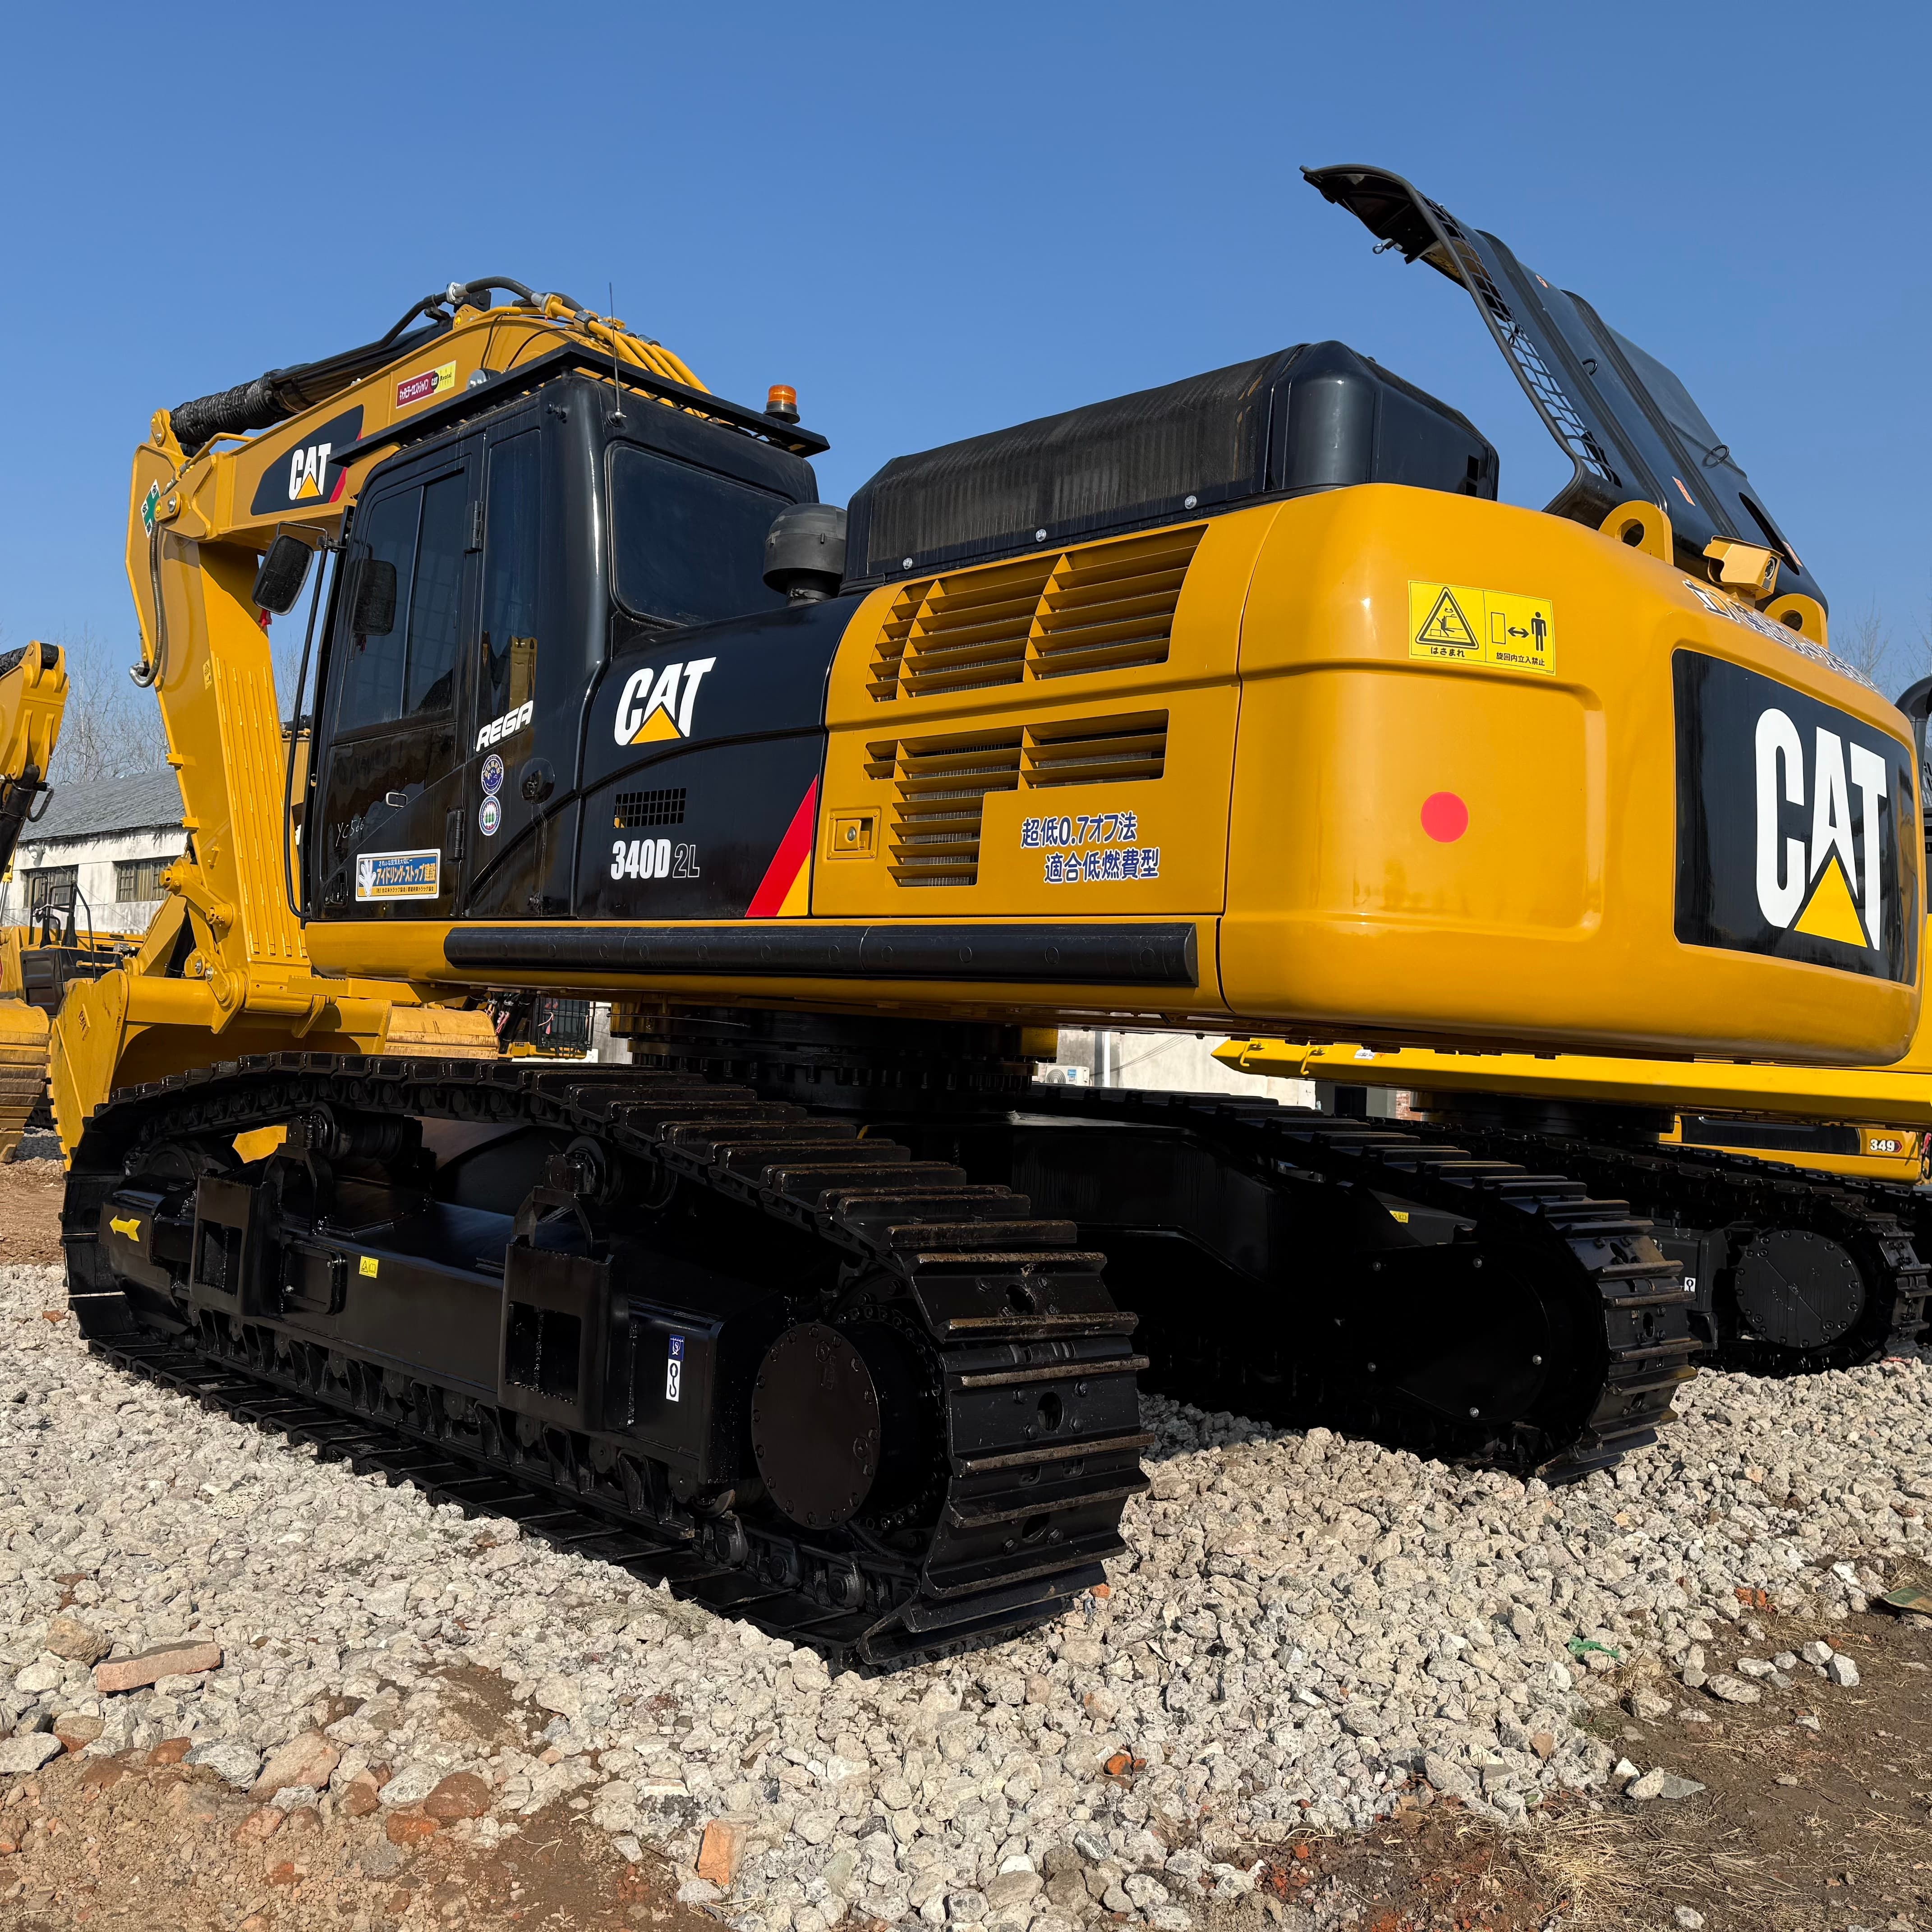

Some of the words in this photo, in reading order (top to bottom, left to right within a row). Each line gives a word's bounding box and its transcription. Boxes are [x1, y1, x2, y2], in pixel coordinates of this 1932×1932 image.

[440, 373, 452, 382] Rental
[289, 442, 331, 501] CAT
[1431, 647, 1465, 658] はさまれ
[1496, 652, 1545, 666] 旋回内立入禁止
[614, 656, 717, 746] CAT
[476, 700, 534, 752] REGA
[335, 817, 366, 847] YC566
[1020, 810, 1138, 848] 超低0.7オフ法
[1755, 708, 1887, 951] CAT
[611, 839, 672, 880] 340D
[672, 843, 700, 878] 2L
[1043, 847, 1160, 884] 適合低燃費型
[1870, 1139, 1895, 1152] 349
